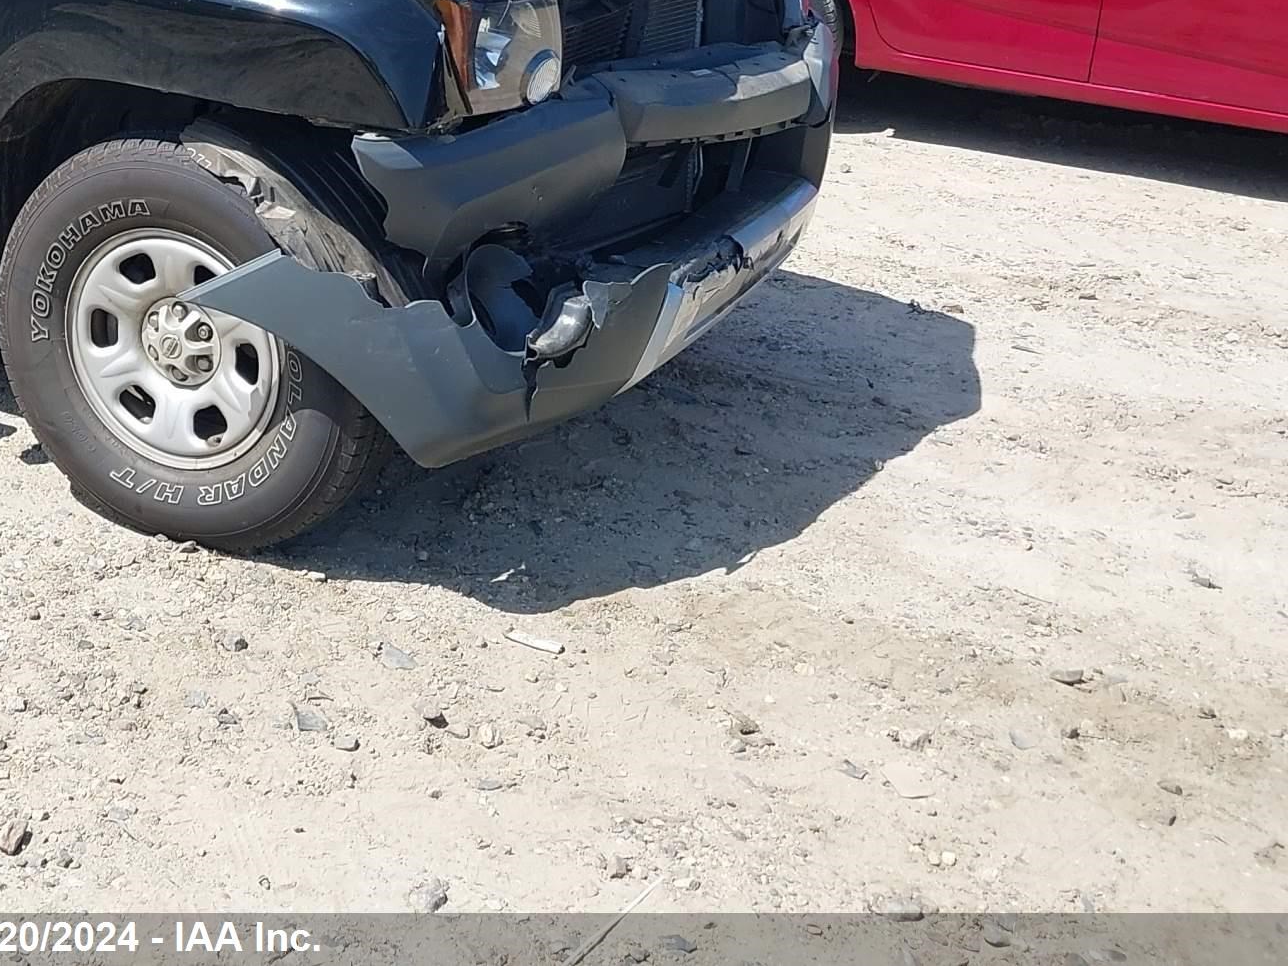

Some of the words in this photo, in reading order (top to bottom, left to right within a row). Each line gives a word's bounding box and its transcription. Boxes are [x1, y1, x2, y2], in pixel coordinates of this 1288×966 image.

[30, 199, 151, 342] YOKOHAMA
[109, 467, 184, 505] H/T
[197, 343, 303, 506] OLANDAR
